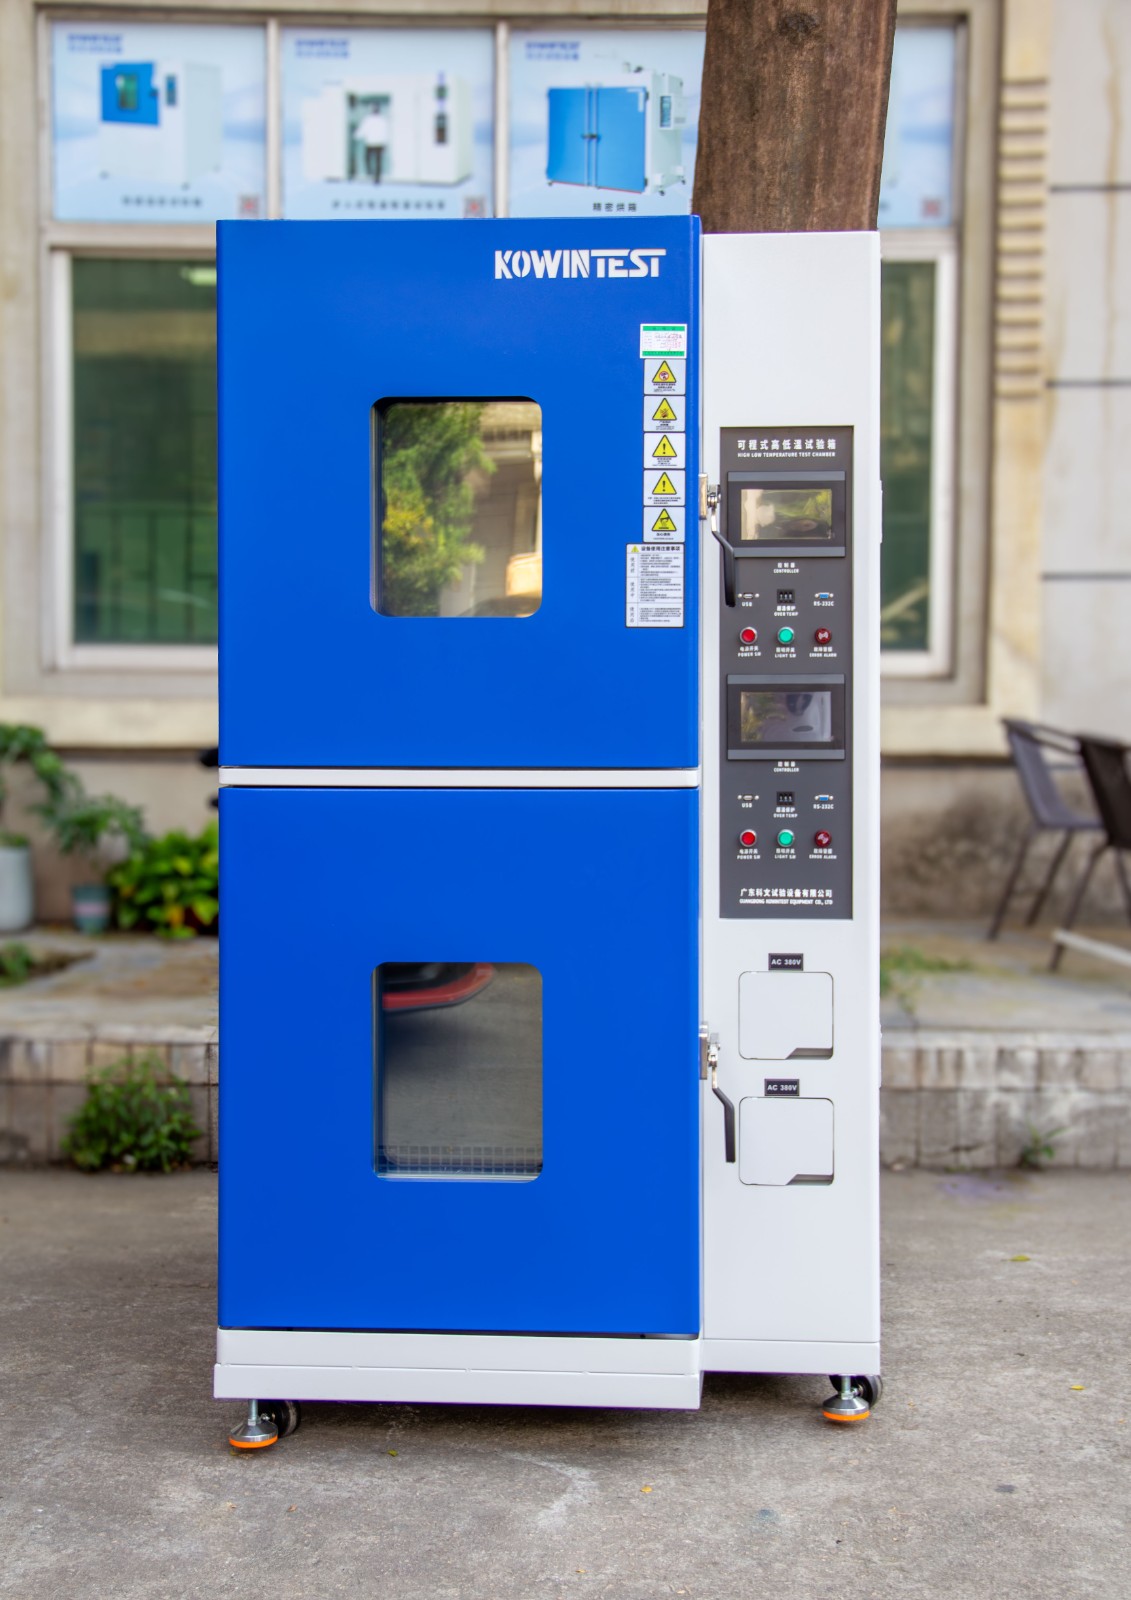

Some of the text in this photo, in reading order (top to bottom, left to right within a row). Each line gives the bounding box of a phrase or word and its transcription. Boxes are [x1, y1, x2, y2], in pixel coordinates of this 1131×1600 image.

[494, 248, 667, 280] KOWINTEST
[737, 439, 836, 450] 可程式高低温试验箱
[740, 888, 833, 898] 广东科文试验设备有限公司
